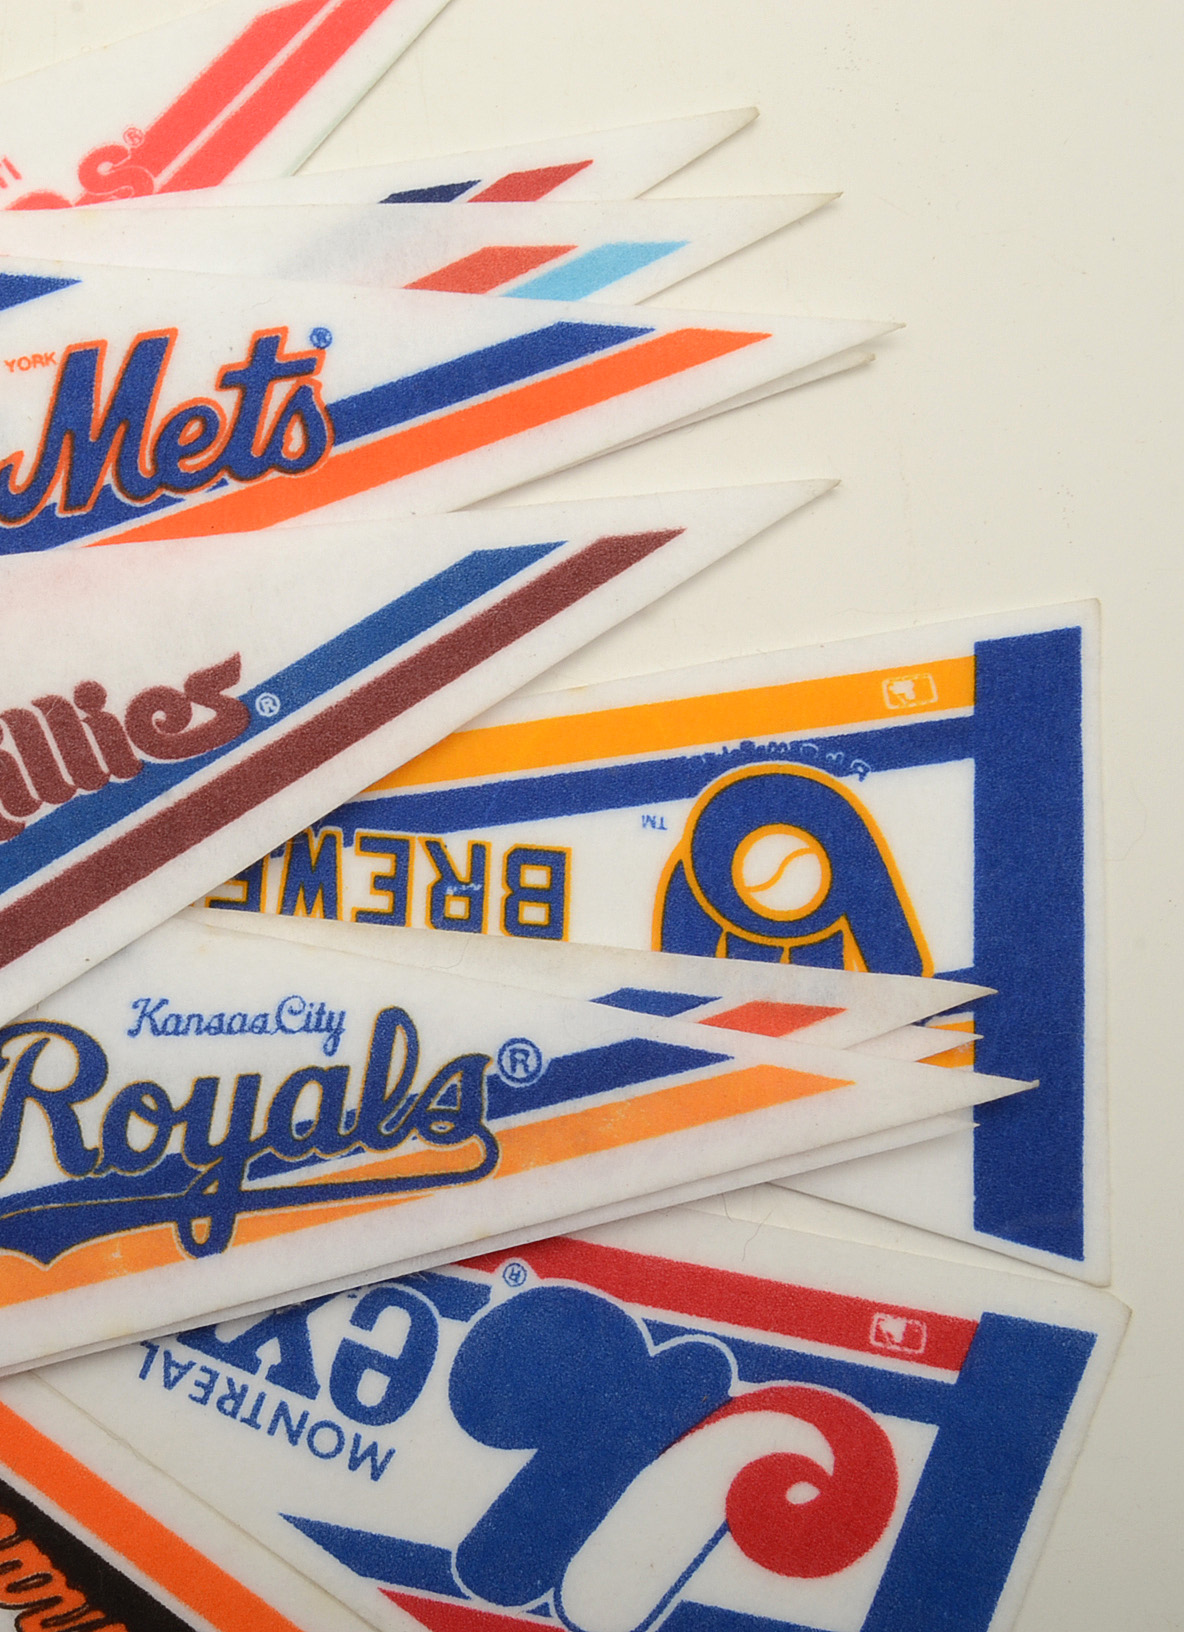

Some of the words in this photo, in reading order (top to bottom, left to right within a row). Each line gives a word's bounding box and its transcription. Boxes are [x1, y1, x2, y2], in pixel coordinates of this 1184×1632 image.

[4, 352, 59, 374] YORK
[273, 994, 347, 1057] City
[138, 1339, 396, 1481] MONTREAL
